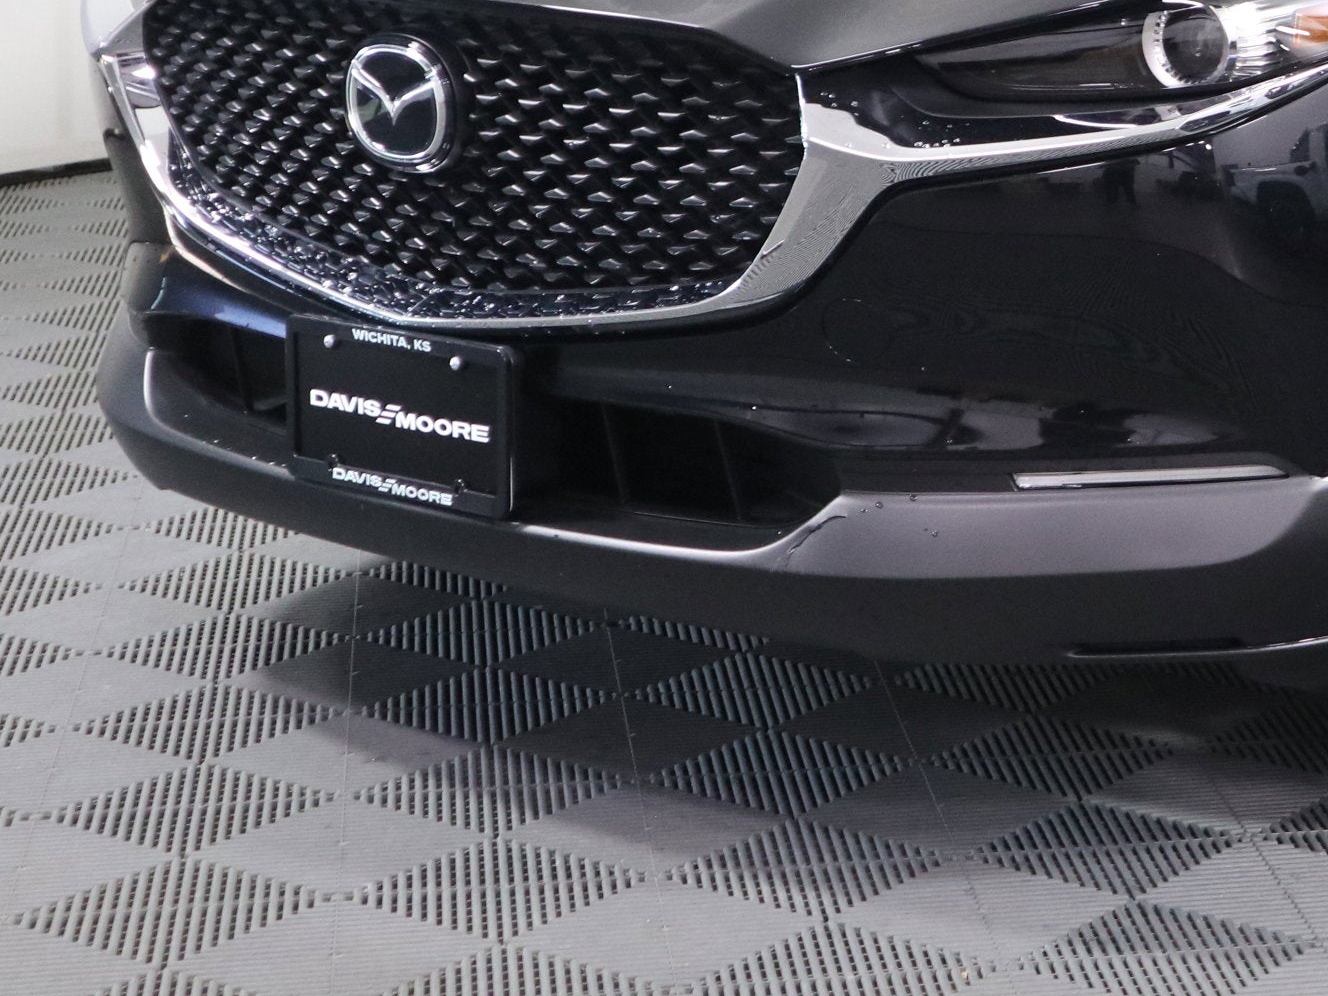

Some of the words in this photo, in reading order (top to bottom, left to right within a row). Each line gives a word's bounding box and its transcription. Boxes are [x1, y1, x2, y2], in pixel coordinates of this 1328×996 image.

[353, 328, 411, 350] WICHITA,
[413, 339, 432, 353] KS
[309, 389, 382, 418] DAVIS
[396, 412, 490, 444] MOORE
[333, 468, 382, 487] DAVIS
[392, 485, 453, 506] MOORE
